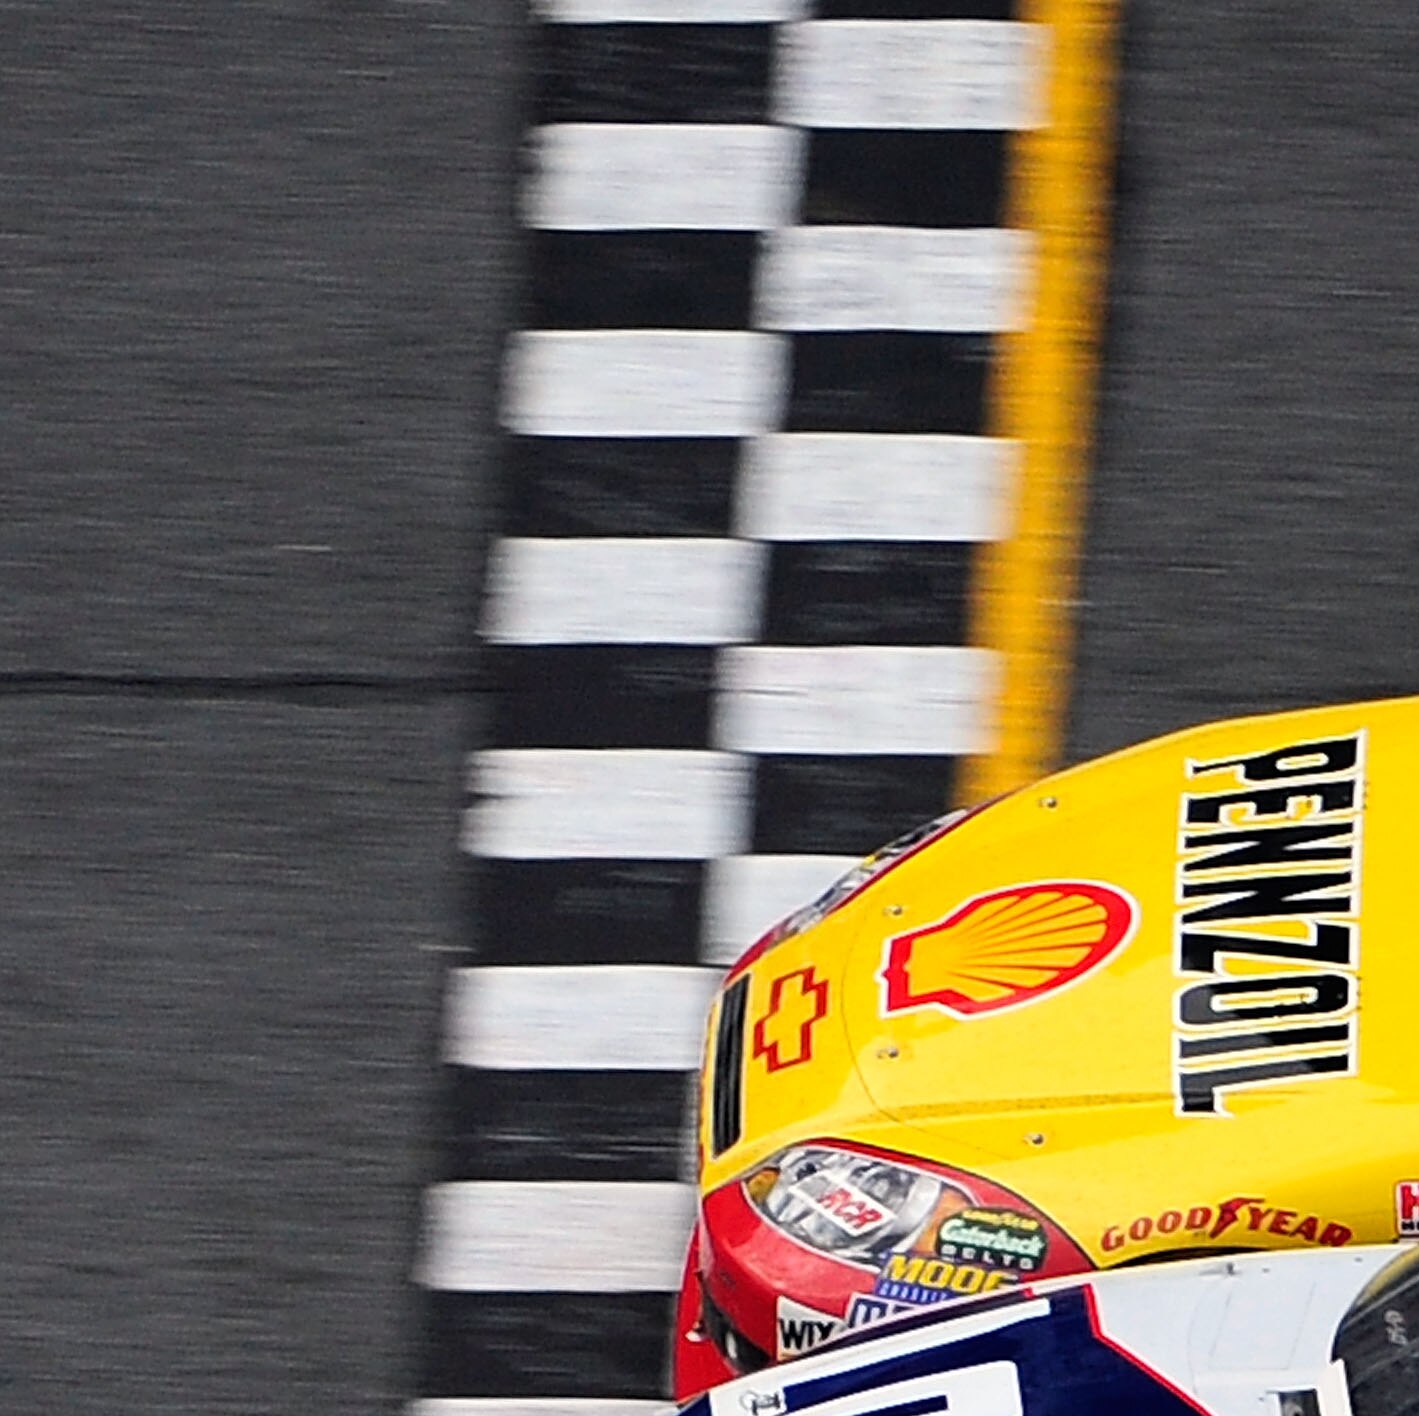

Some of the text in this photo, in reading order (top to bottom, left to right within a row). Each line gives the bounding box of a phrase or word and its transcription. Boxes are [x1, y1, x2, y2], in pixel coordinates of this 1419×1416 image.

[1171, 728, 1367, 1119] PENNZOIL
[1099, 1197, 1353, 1253] GOODYEAR
[778, 1316, 836, 1350] WIX
